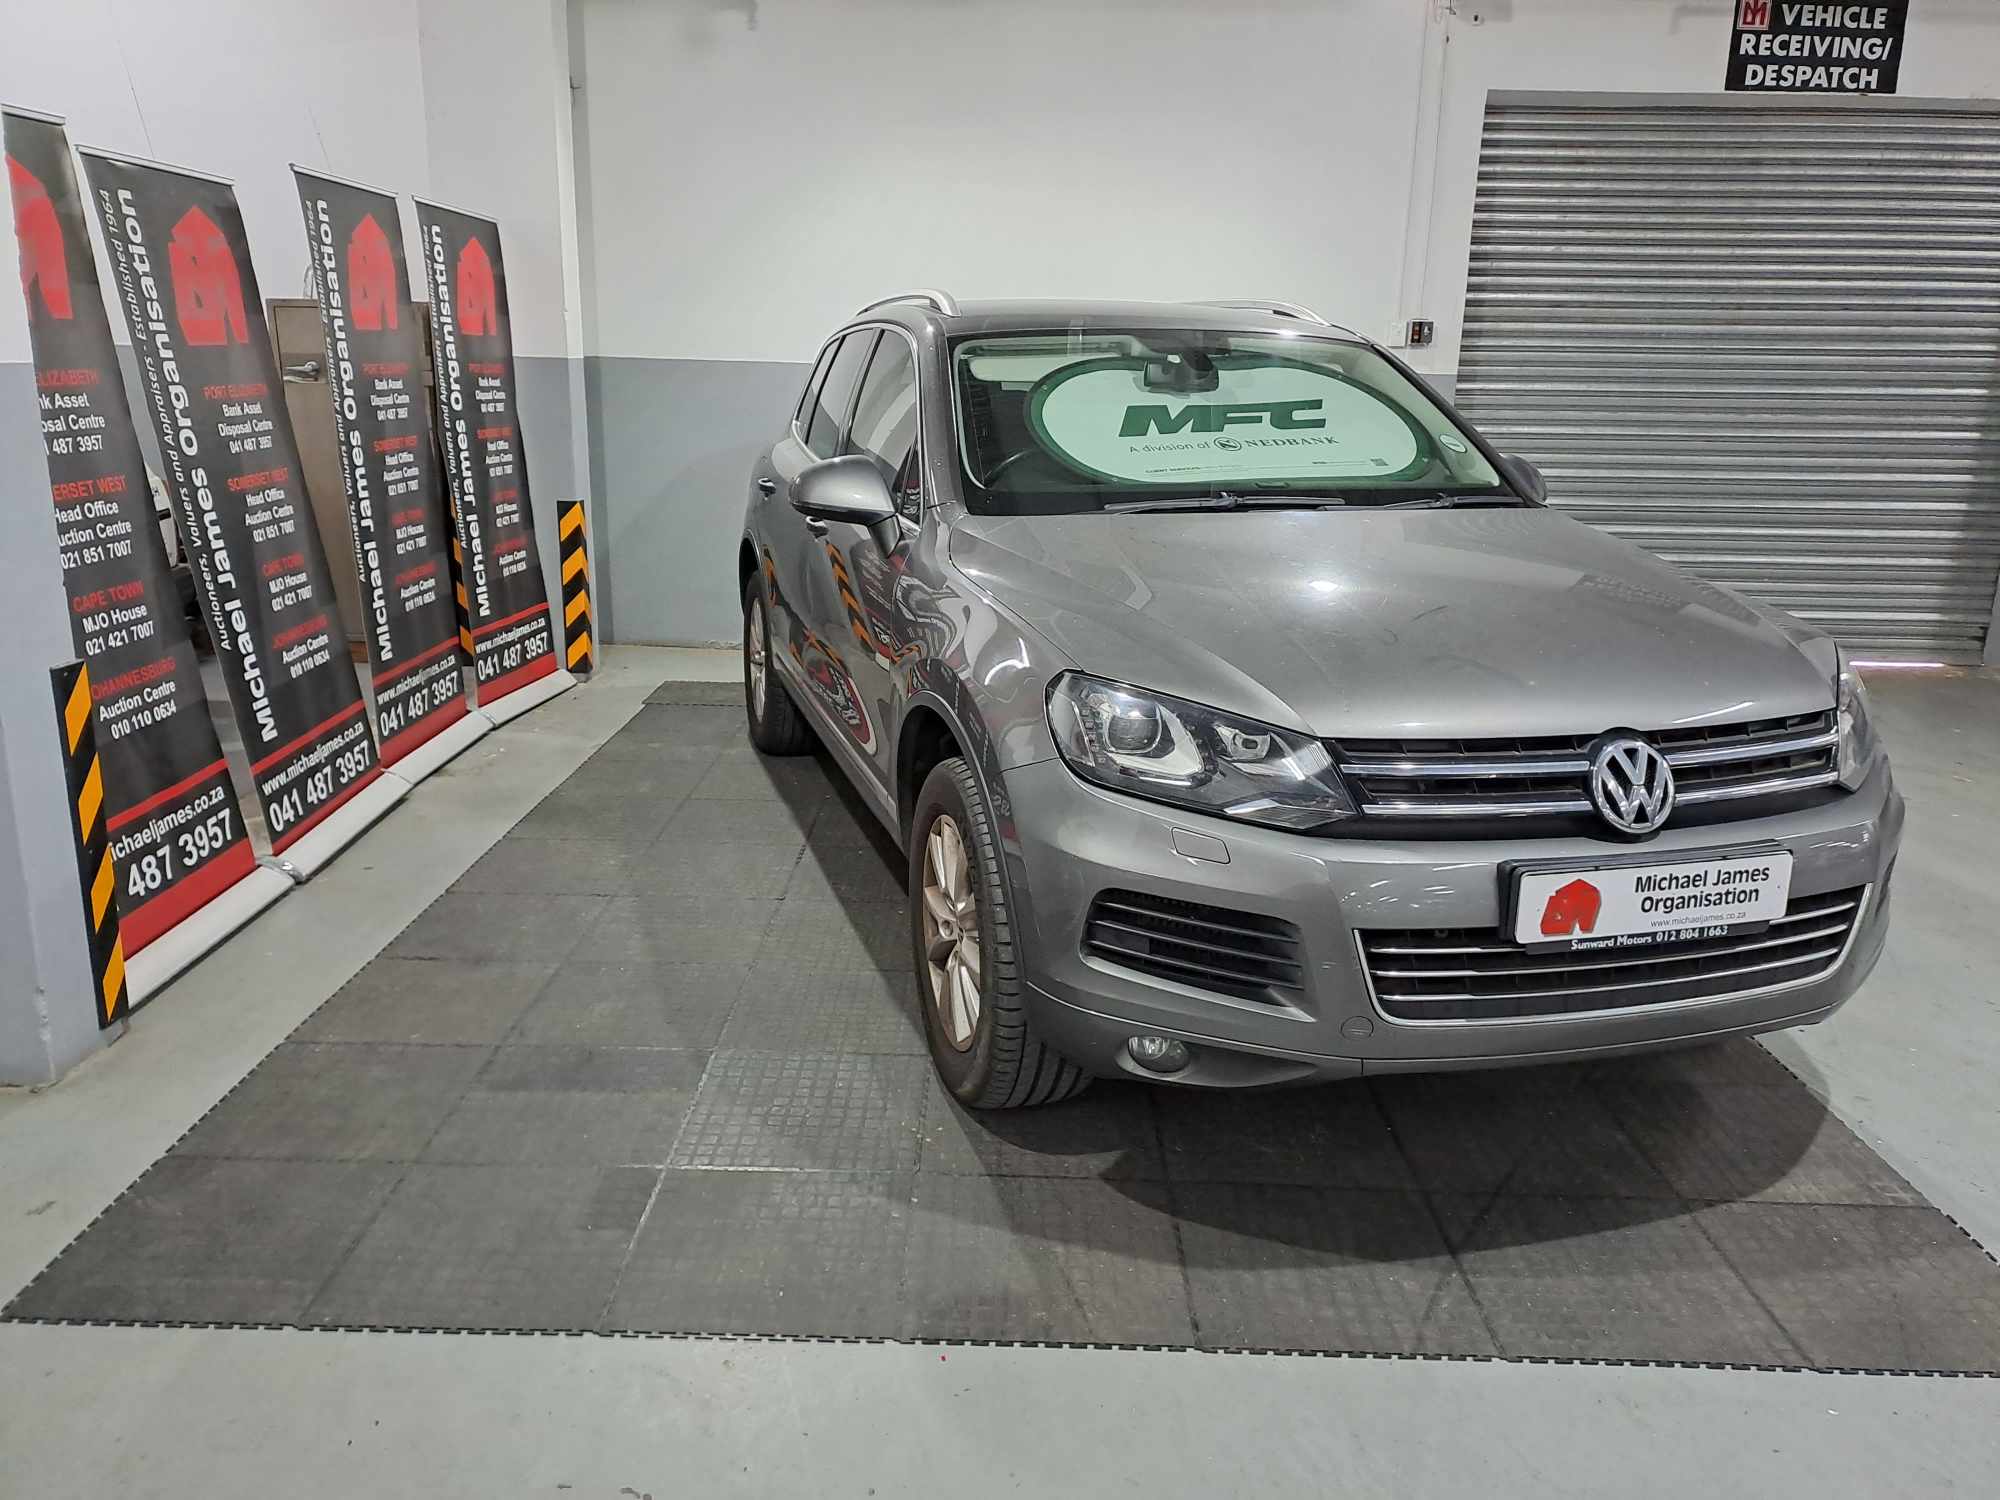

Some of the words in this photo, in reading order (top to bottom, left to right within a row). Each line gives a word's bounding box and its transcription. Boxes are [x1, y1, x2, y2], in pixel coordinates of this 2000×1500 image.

[1781, 4, 1888, 29] VEHICLE
[1739, 33, 1894, 61] RECEIVING/
[1744, 64, 1880, 90] DESPATCH
[99, 189, 119, 234] 1964
[111, 238, 147, 341] Established
[118, 189, 198, 456] Organisation
[316, 199, 357, 421] Organisation
[431, 224, 463, 411] Organisation
[54, 393, 90, 409] Asset
[144, 356, 175, 446] Appraisers
[222, 403, 242, 417] Bank
[1118, 399, 1327, 437] MFC
[68, 414, 106, 430] Centre
[218, 421, 251, 437] Disposal
[52, 437, 73, 454] 487
[76, 435, 103, 452] 3957
[229, 440, 242, 454] 041
[1129, 445, 1139, 453] A
[1142, 441, 1193, 453] division
[1197, 441, 1211, 449] of
[1244, 436, 1340, 447] NEDBANK
[167, 450, 185, 482] and
[349, 430, 374, 533] James
[455, 419, 476, 507] James
[96, 474, 126, 494] WEST
[84, 501, 119, 519] Office
[179, 487, 203, 548] Valuers
[191, 467, 237, 589] James
[96, 520, 132, 539] Centre
[60, 551, 81, 570] 021
[83, 546, 105, 564] 851
[107, 540, 132, 559] 7007
[465, 514, 491, 617] Michael
[82, 609, 109, 634] MJO
[111, 604, 148, 626] House
[199, 554, 231, 651] Auctioneers,
[363, 541, 393, 662] Michael
[85, 636, 105, 656] 021
[108, 630, 129, 648] 421
[130, 620, 155, 641] 7007
[477, 653, 500, 681] 041
[502, 643, 521, 669] 487
[524, 631, 548, 660] 3957
[224, 599, 278, 742] Michael
[100, 697, 143, 722] Auction
[143, 680, 176, 703] Centre
[111, 722, 132, 740] 010
[131, 711, 152, 730] 110
[153, 699, 177, 722] 0634
[380, 702, 404, 737] 041
[408, 688, 428, 719] 487
[432, 670, 458, 706] 3957
[269, 787, 304, 832] 041
[306, 764, 334, 804] 487
[336, 739, 370, 784] 3957
[128, 844, 173, 897] 487
[178, 807, 232, 867] 3957
[1635, 870, 1708, 893] Michael
[1712, 867, 1770, 887] James
[1641, 887, 1759, 914] Organisation
[1571, 934, 1615, 950] Sunward
[1616, 932, 1652, 947] Motors
[1656, 930, 1676, 942] 012
[1679, 927, 1699, 940] 804
[1703, 925, 1728, 937] 1663
